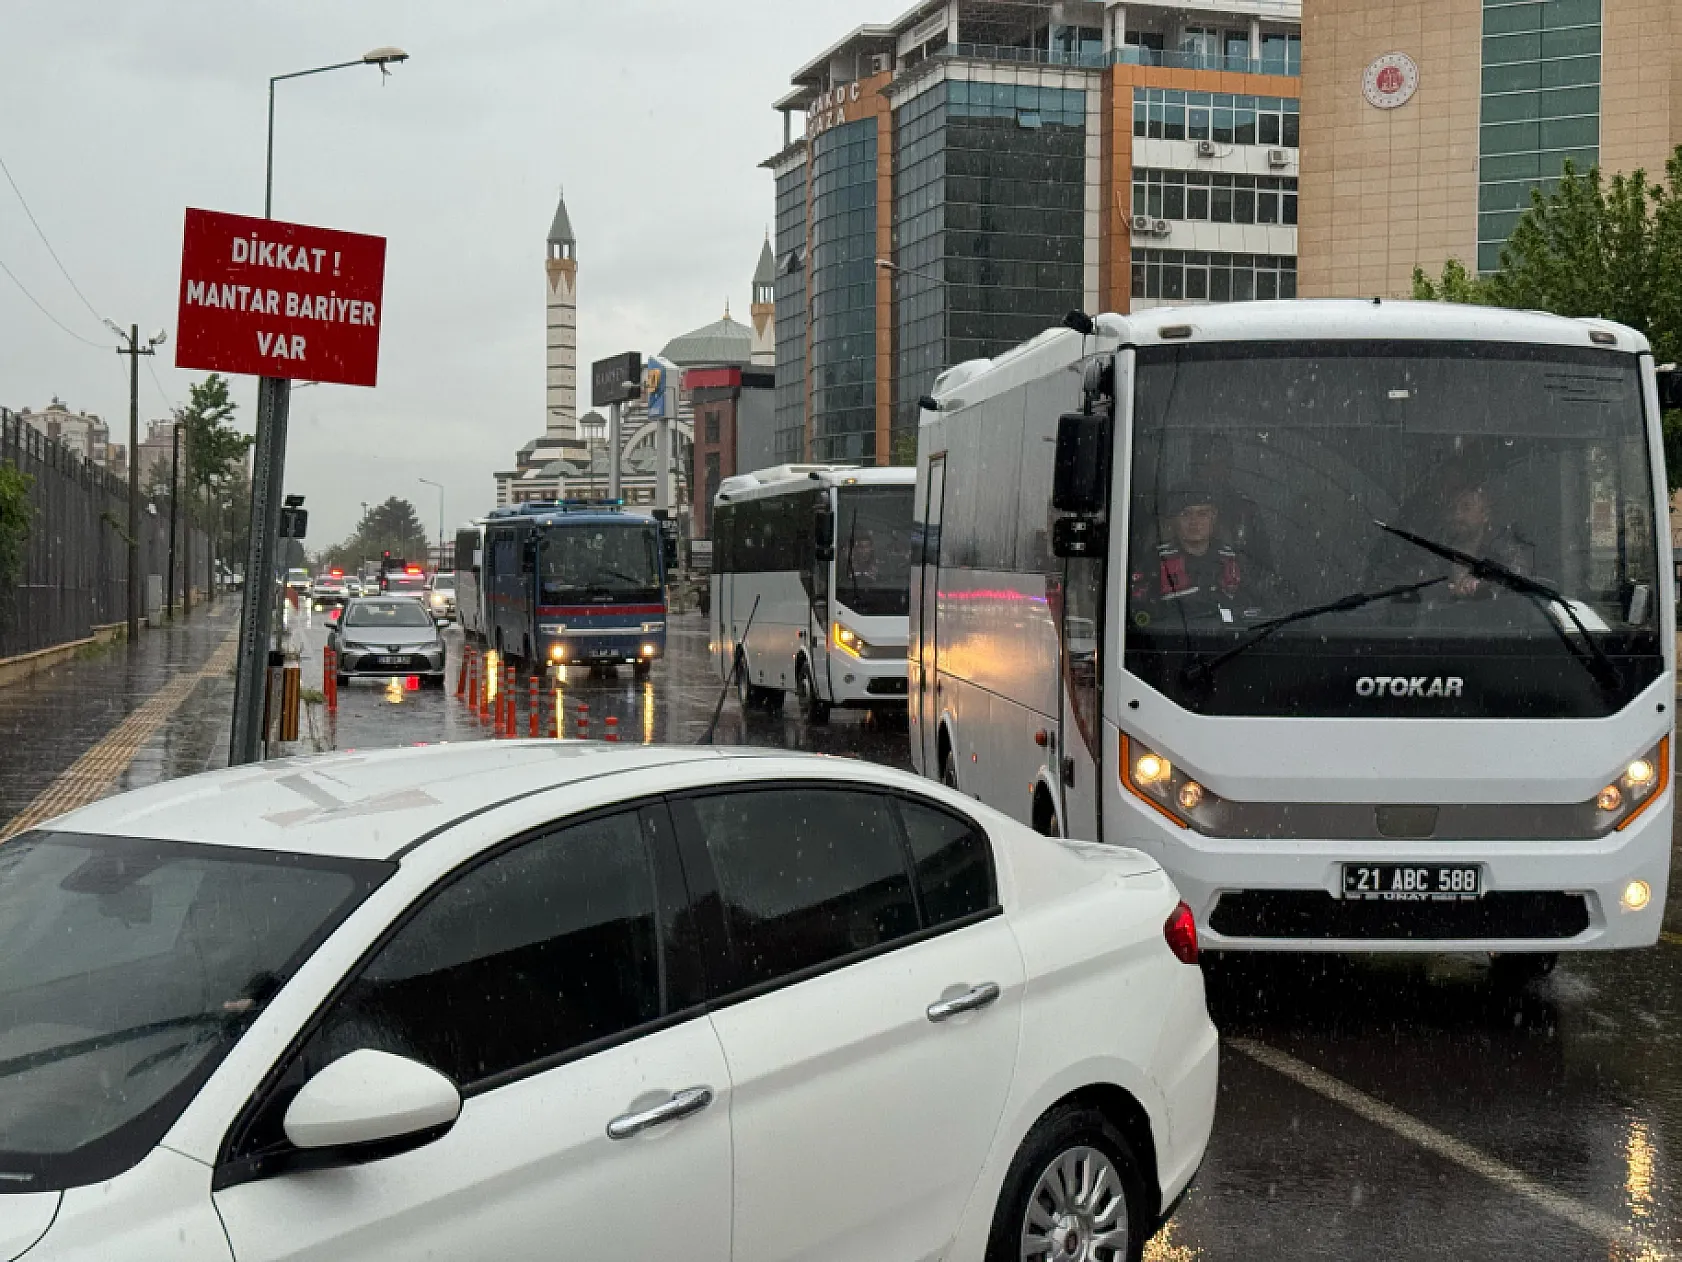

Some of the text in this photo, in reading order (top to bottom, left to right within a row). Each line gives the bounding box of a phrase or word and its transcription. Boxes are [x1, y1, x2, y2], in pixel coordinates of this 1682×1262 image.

[231, 232, 327, 273] DİKKAT
[186, 279, 376, 327] MANTAR BARİYER
[256, 330, 307, 361] VAR
[1355, 676, 1464, 697] OTOKAR
[1357, 867, 1476, 892] 21 ABC 588
